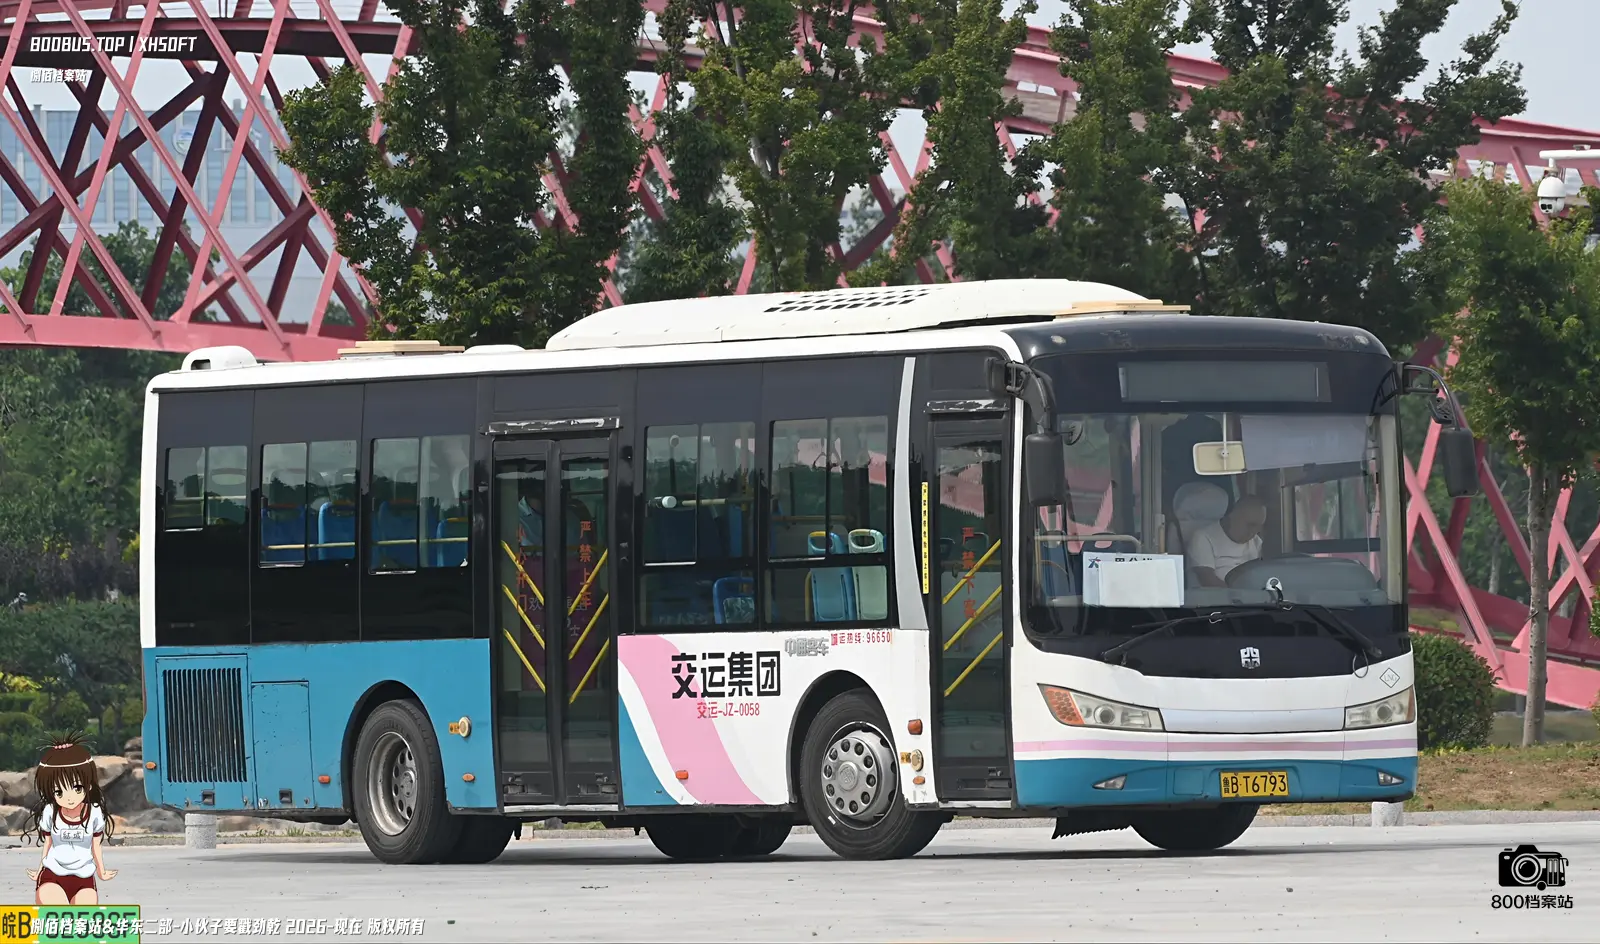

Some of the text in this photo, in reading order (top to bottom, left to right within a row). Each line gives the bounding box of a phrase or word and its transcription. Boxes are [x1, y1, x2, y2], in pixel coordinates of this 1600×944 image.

[671, 651, 781, 699] 交运集团
[697, 701, 760, 719] 交运-JZ-0058
